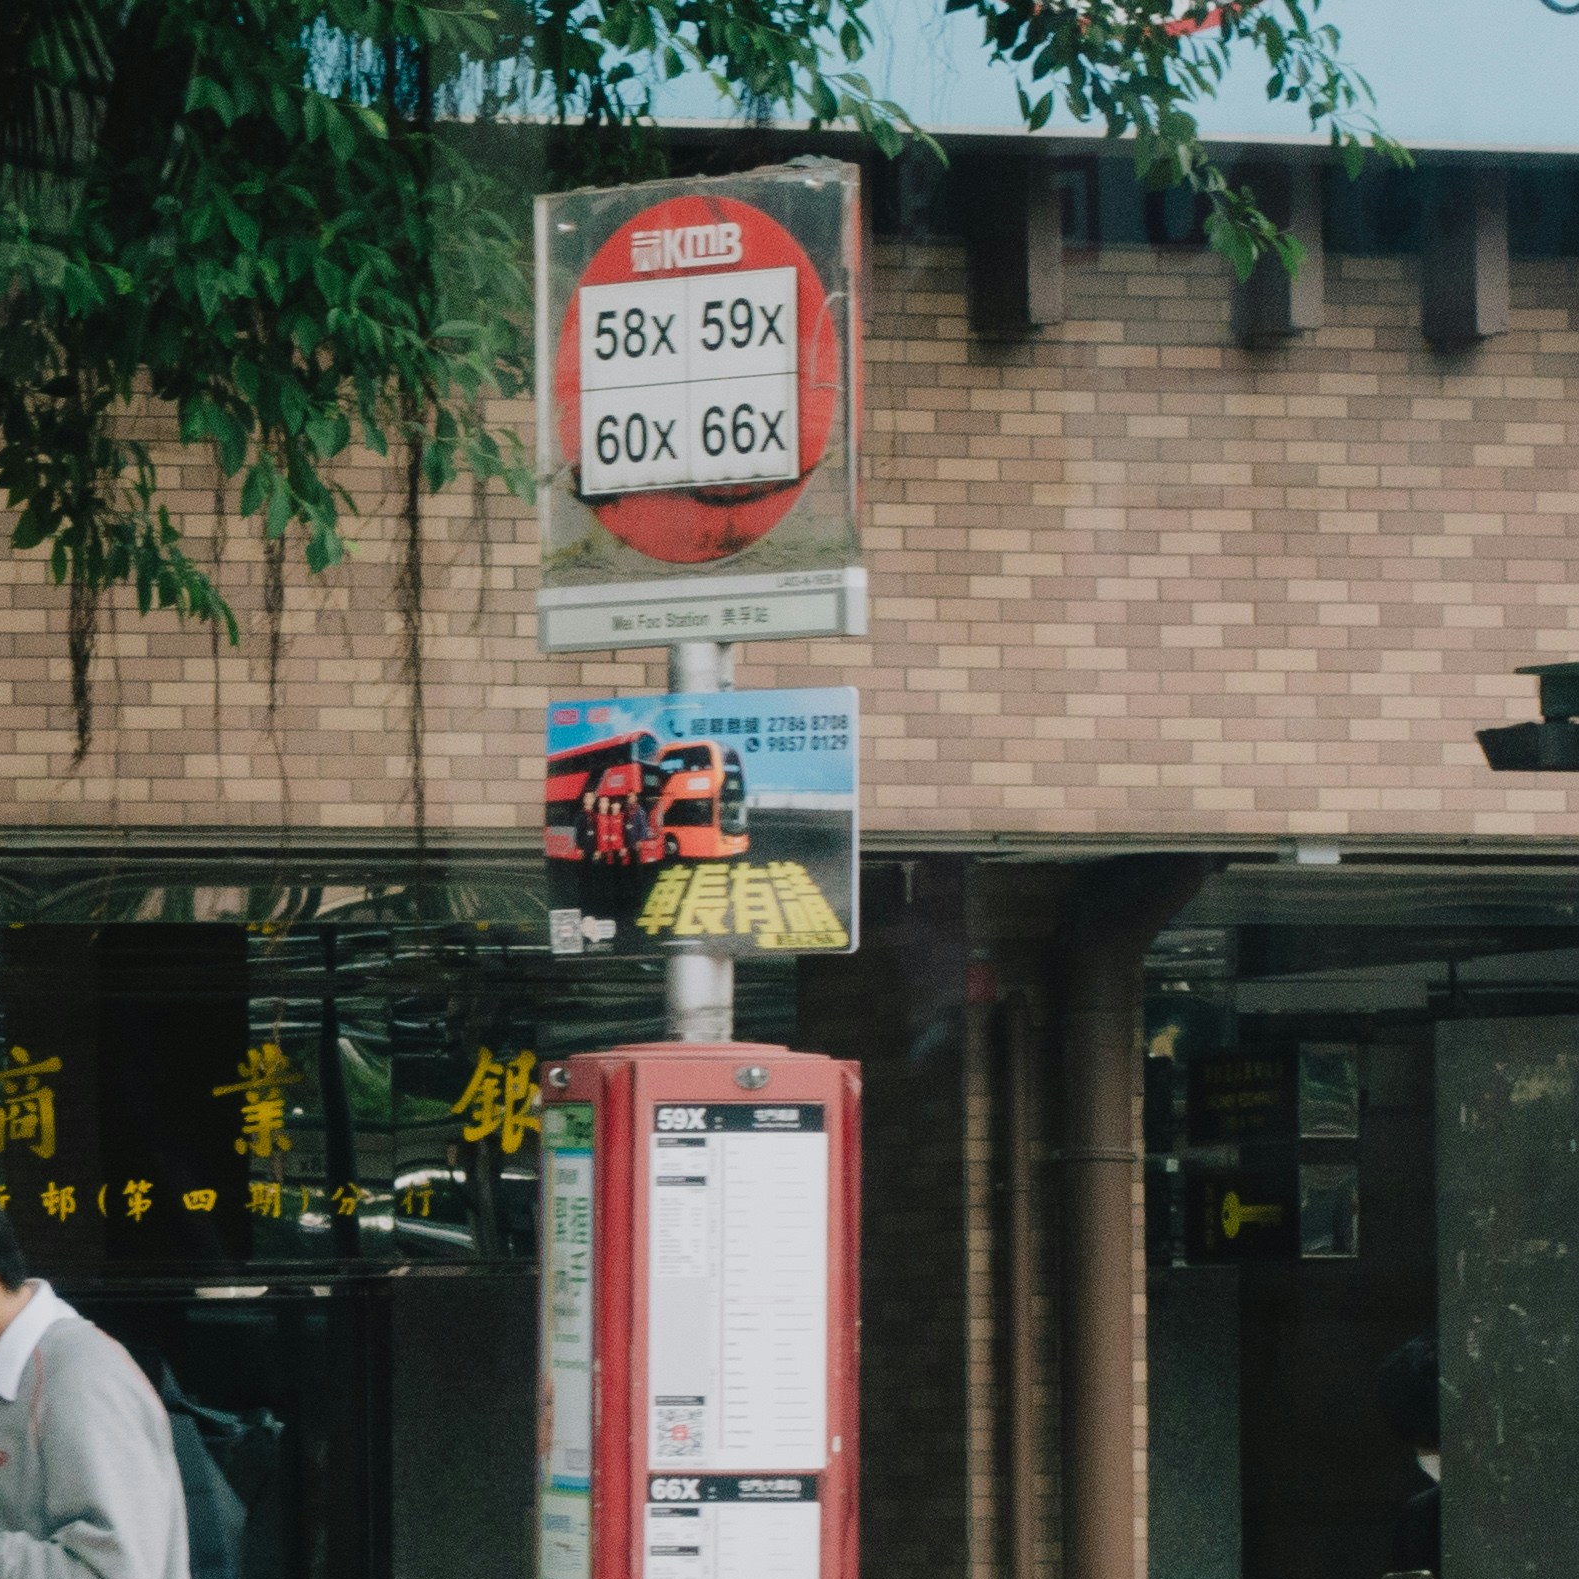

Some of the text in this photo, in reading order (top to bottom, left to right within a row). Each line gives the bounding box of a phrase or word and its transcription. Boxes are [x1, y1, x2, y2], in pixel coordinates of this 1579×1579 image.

[665, 222, 743, 269] KMB
[594, 298, 786, 361] 58X 59X
[595, 403, 788, 466] 60X 66X
[611, 615, 635, 632] Mei
[666, 611, 709, 629] Station
[657, 1107, 707, 1131] 59X
[650, 1478, 700, 1501] 66X
